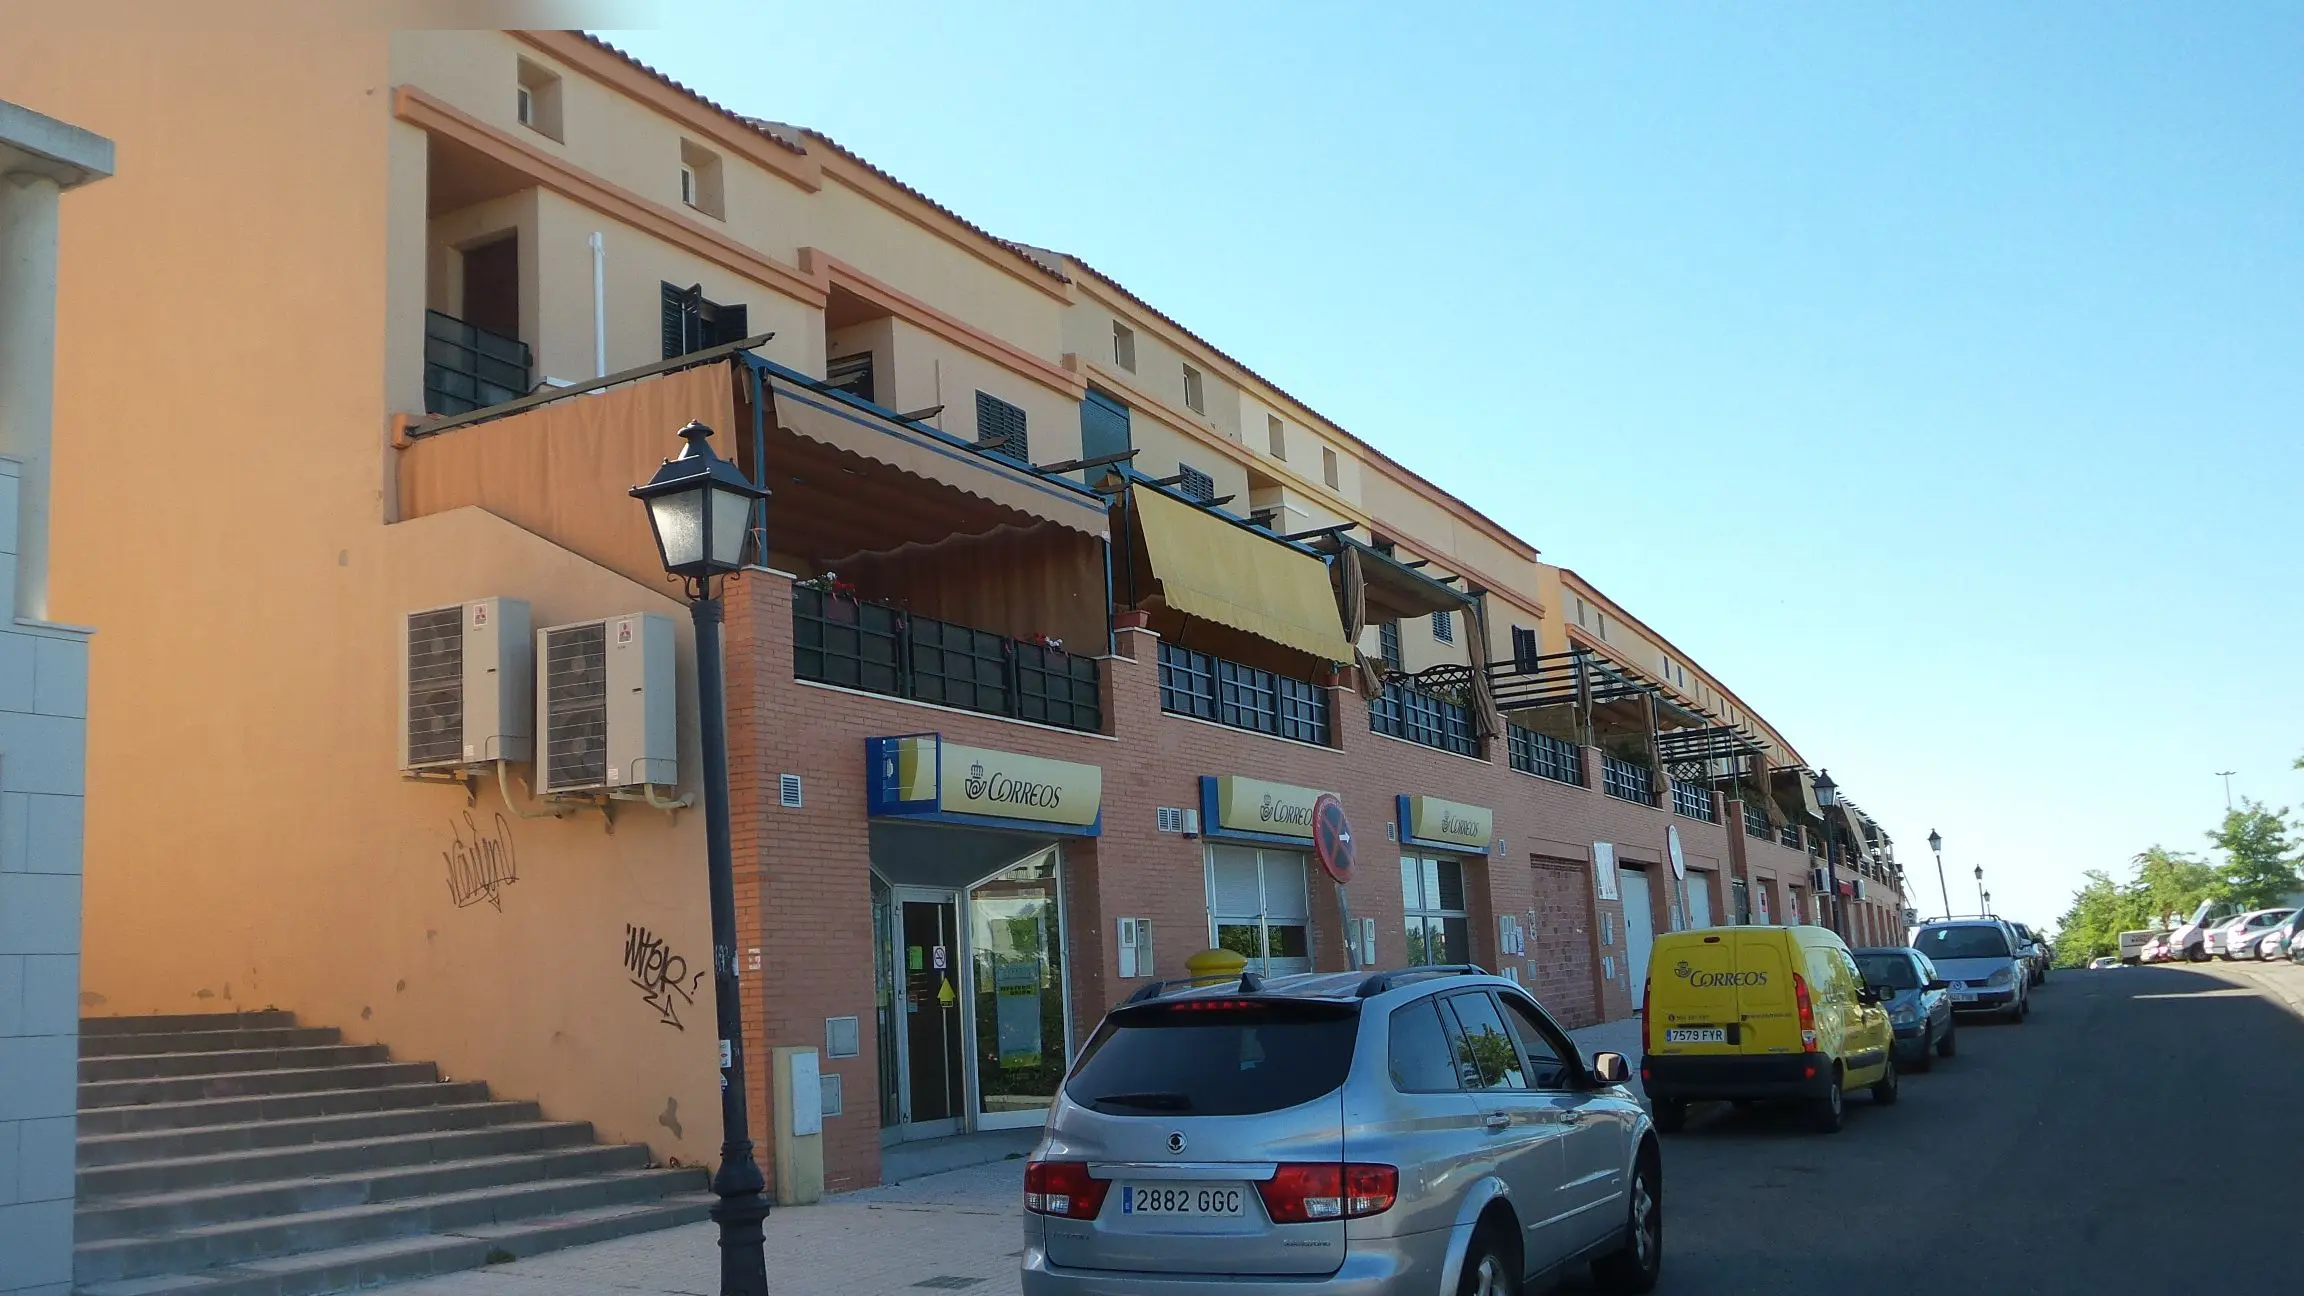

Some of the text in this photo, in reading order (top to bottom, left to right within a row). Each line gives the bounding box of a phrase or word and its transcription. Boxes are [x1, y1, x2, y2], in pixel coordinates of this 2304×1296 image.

[988, 772, 1062, 808] CORREOS
[1274, 800, 1313, 826] CORREO
[1450, 815, 1479, 837] CORREOS
[1690, 970, 1767, 987] CORREOS
[1672, 1030, 1723, 1041] 7579 FYR
[1136, 1189, 1239, 1212] 2882 GGC
